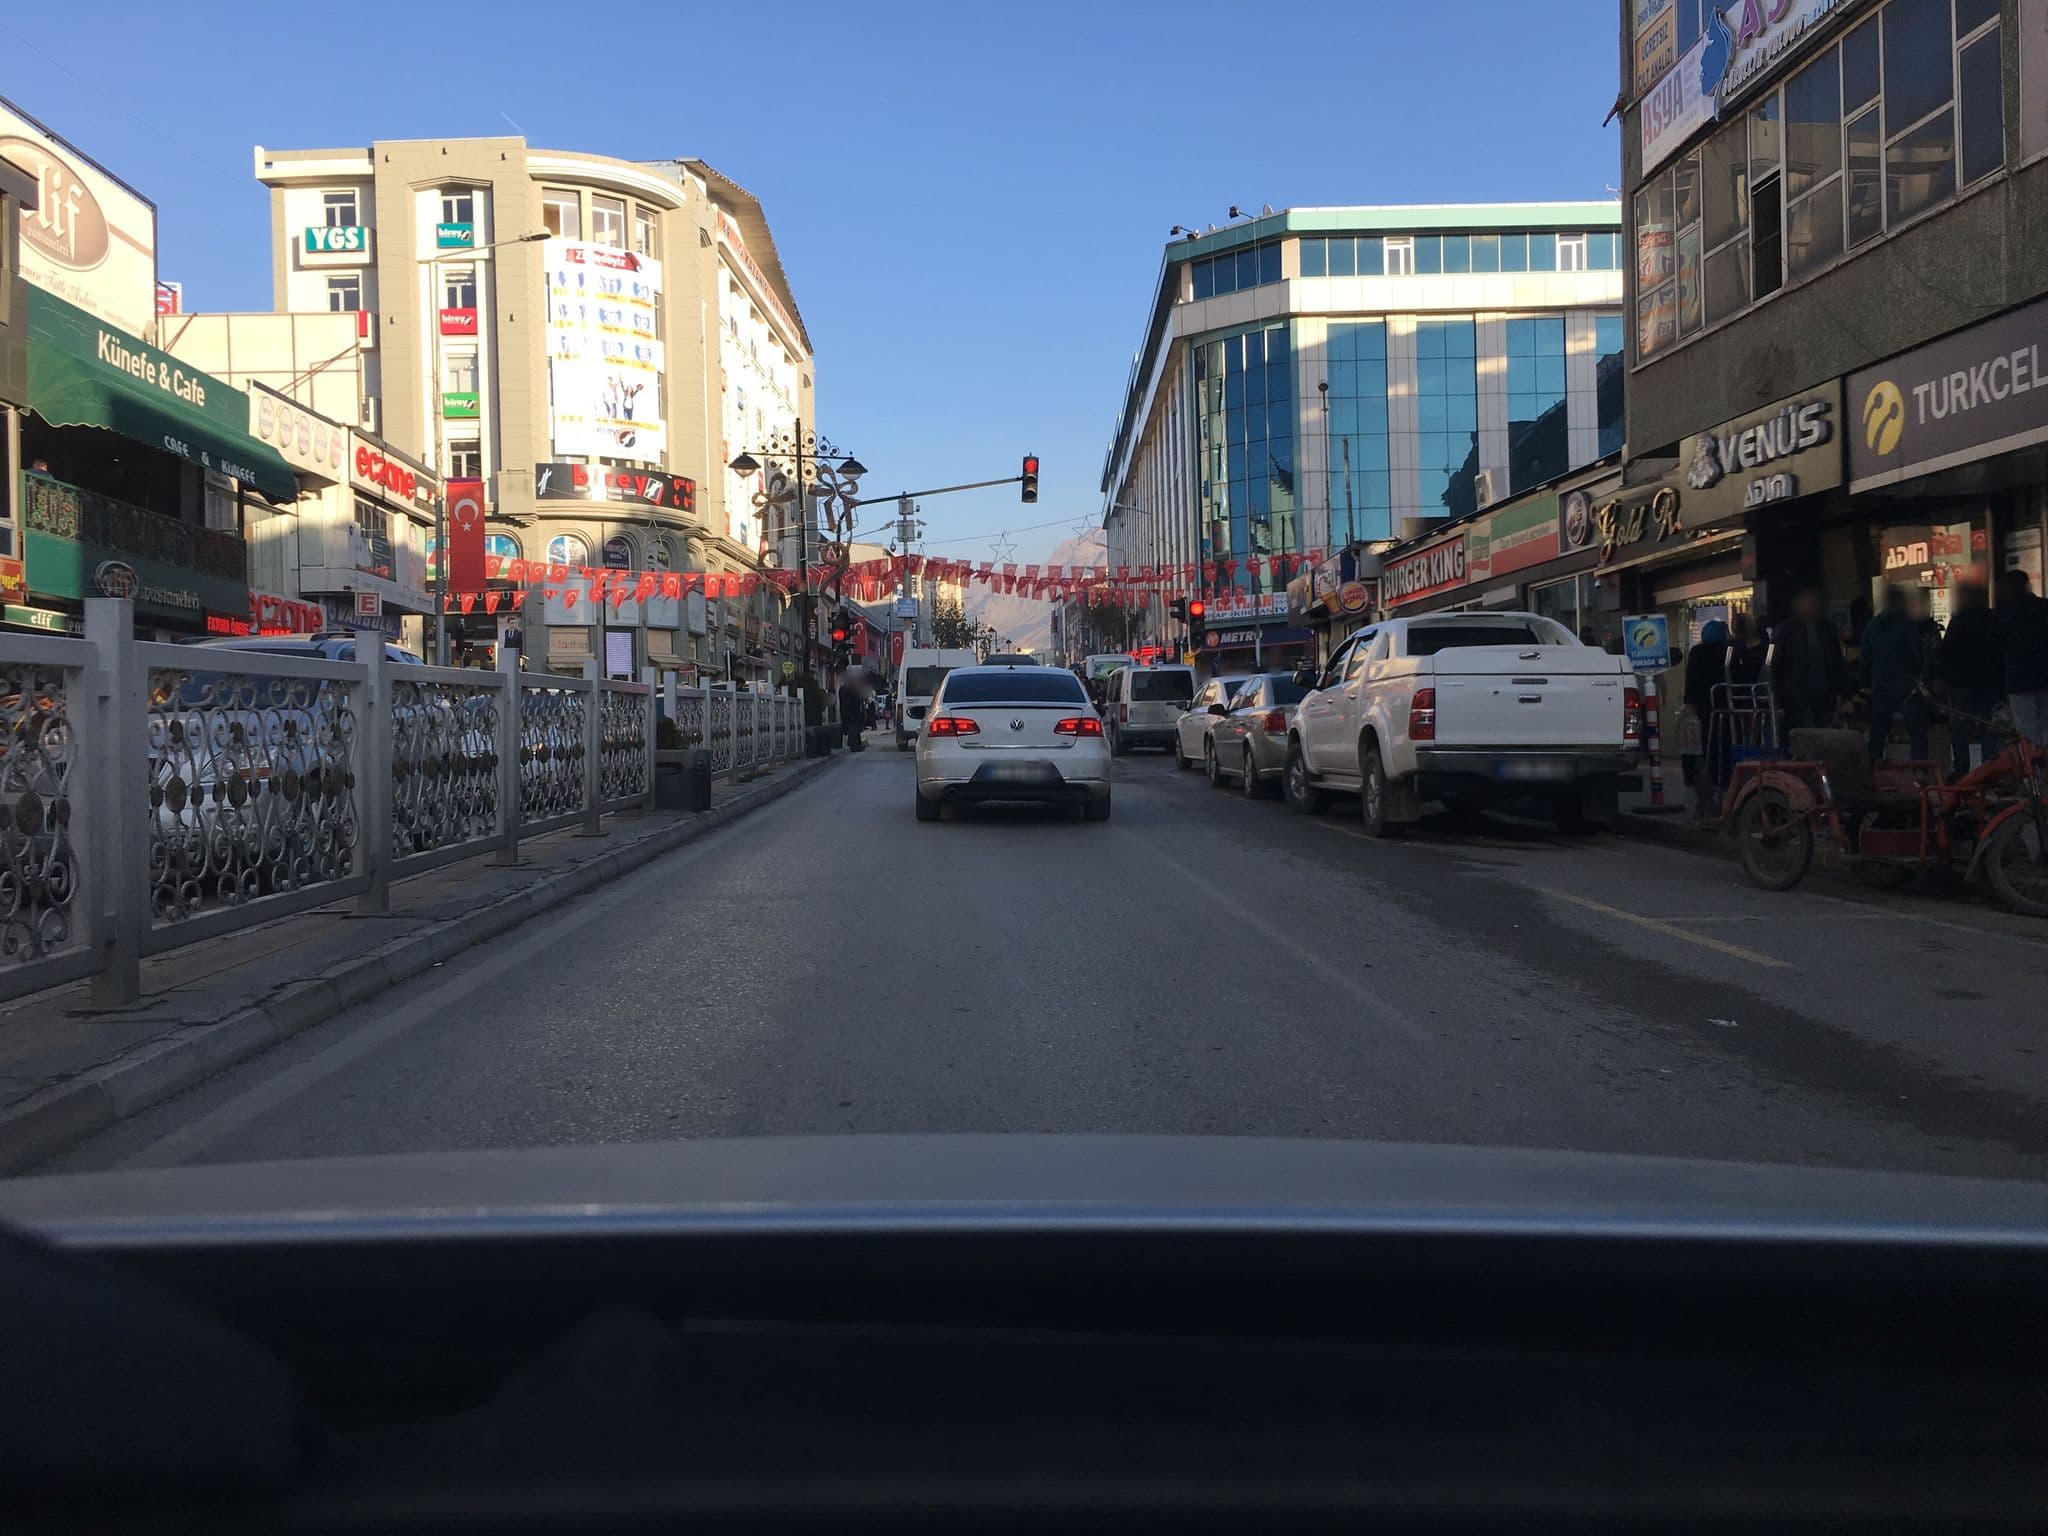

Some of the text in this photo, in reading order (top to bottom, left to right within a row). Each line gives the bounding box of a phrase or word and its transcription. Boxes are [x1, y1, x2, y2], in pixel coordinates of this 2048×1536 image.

[1643, 69, 1685, 150] ASYA
[21, 163, 84, 260] lif
[312, 230, 359, 249] YGS
[438, 228, 463, 241] birey
[442, 314, 467, 326] birey
[98, 330, 205, 407] Künefe & Cafe
[444, 397, 469, 410] birey
[164, 435, 190, 458] CAFE
[1719, 400, 1827, 473] VENÜS
[356, 446, 415, 501] eczane
[1385, 553, 1427, 600] BURGER
[1430, 541, 1464, 585] KING
[360, 596, 375, 611] E
[30, 613, 54, 627] elif
[1220, 631, 1263, 643] METRO
